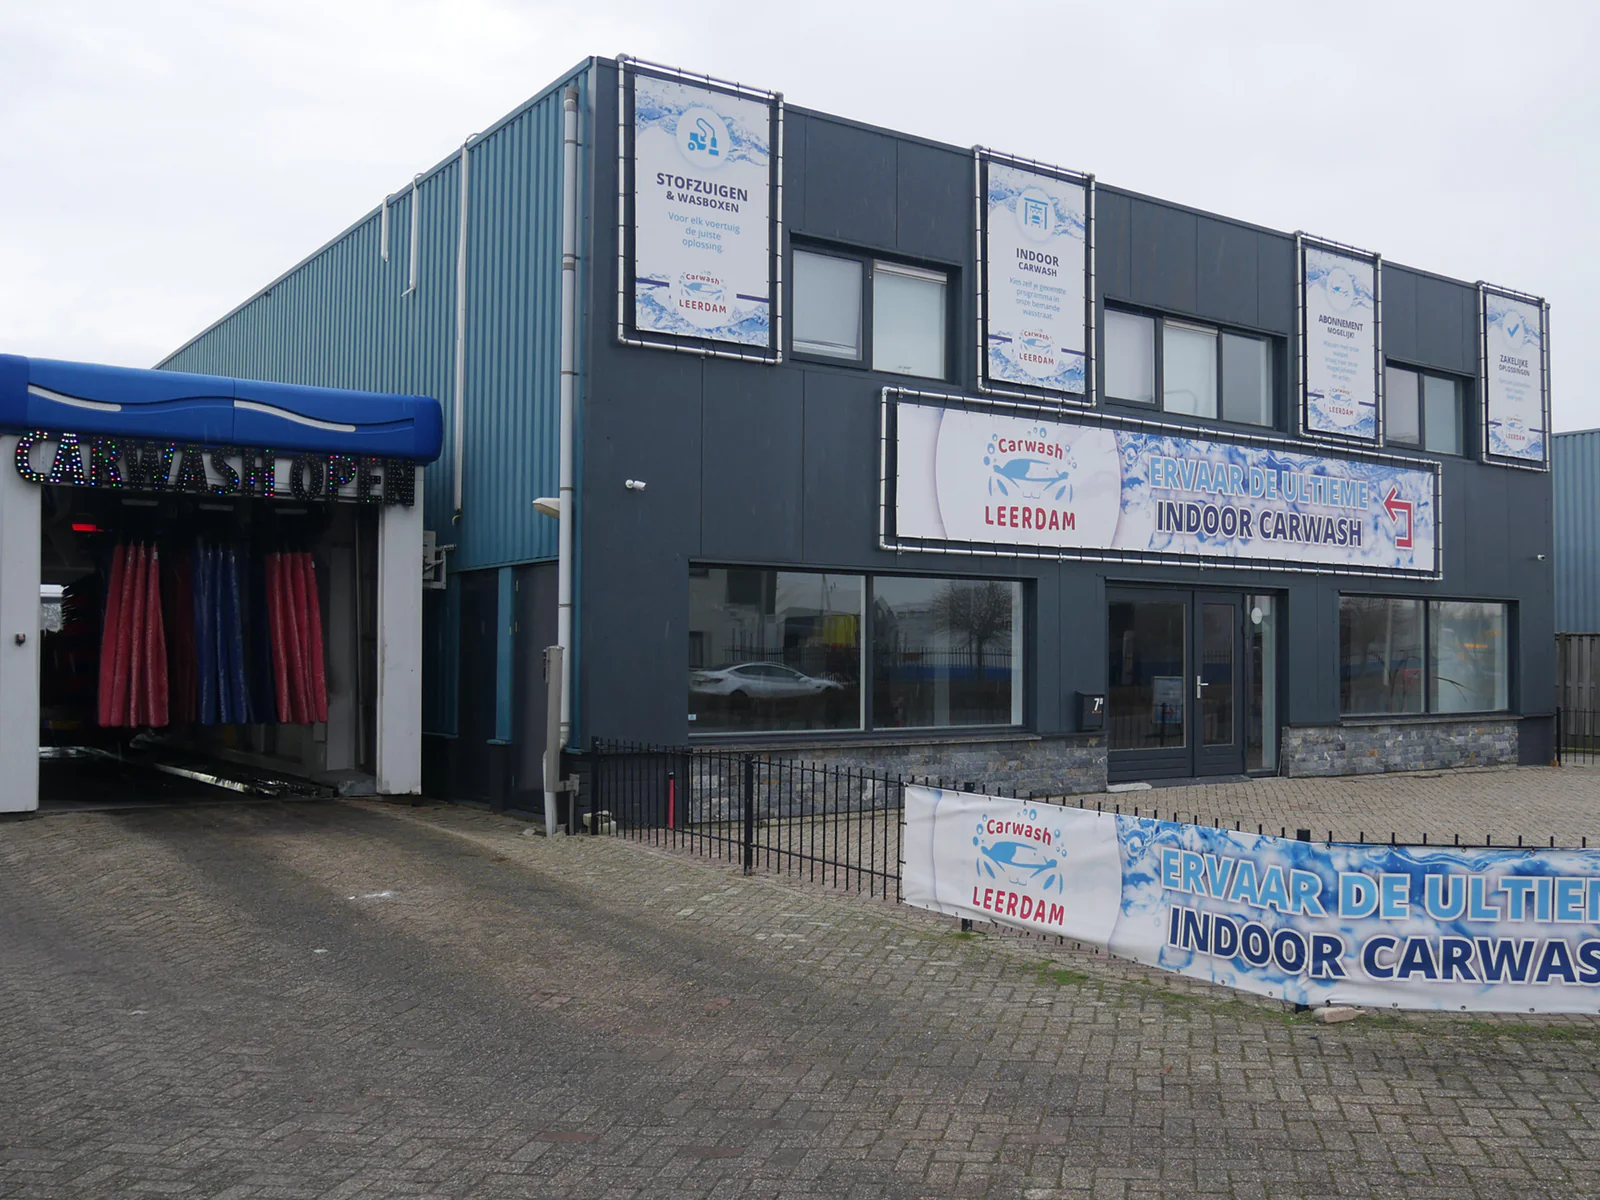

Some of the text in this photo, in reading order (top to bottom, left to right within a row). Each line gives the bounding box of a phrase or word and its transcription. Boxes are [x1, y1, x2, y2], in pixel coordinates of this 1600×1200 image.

[656, 172, 748, 202] STOFZUIGEN
[666, 190, 739, 213] & WASBOXEN
[668, 212, 740, 235] Voor elk voertuig
[685, 226, 721, 240] de juiste
[1016, 247, 1059, 267] INDOOR
[686, 273, 720, 285] Carwash
[1018, 261, 1057, 277] CARWASH
[679, 299, 727, 314] LEERDAM
[1318, 314, 1364, 332] ABONNEMENT
[1019, 352, 1055, 365] LEERDAM
[998, 438, 1064, 460] Carwash
[14, 430, 416, 506] CARWASH OPEN
[1150, 455, 1369, 510] ERVAAR DE ULTIEME
[985, 505, 1076, 531] LEERDAM
[1156, 500, 1363, 547] INDOOR CARWASH
[986, 818, 1052, 846] Carwash
[1160, 847, 1600, 923] ERVAAR DE ULTIE
[972, 886, 1065, 926] LEERDAM
[1168, 905, 1350, 979] INDOOR
